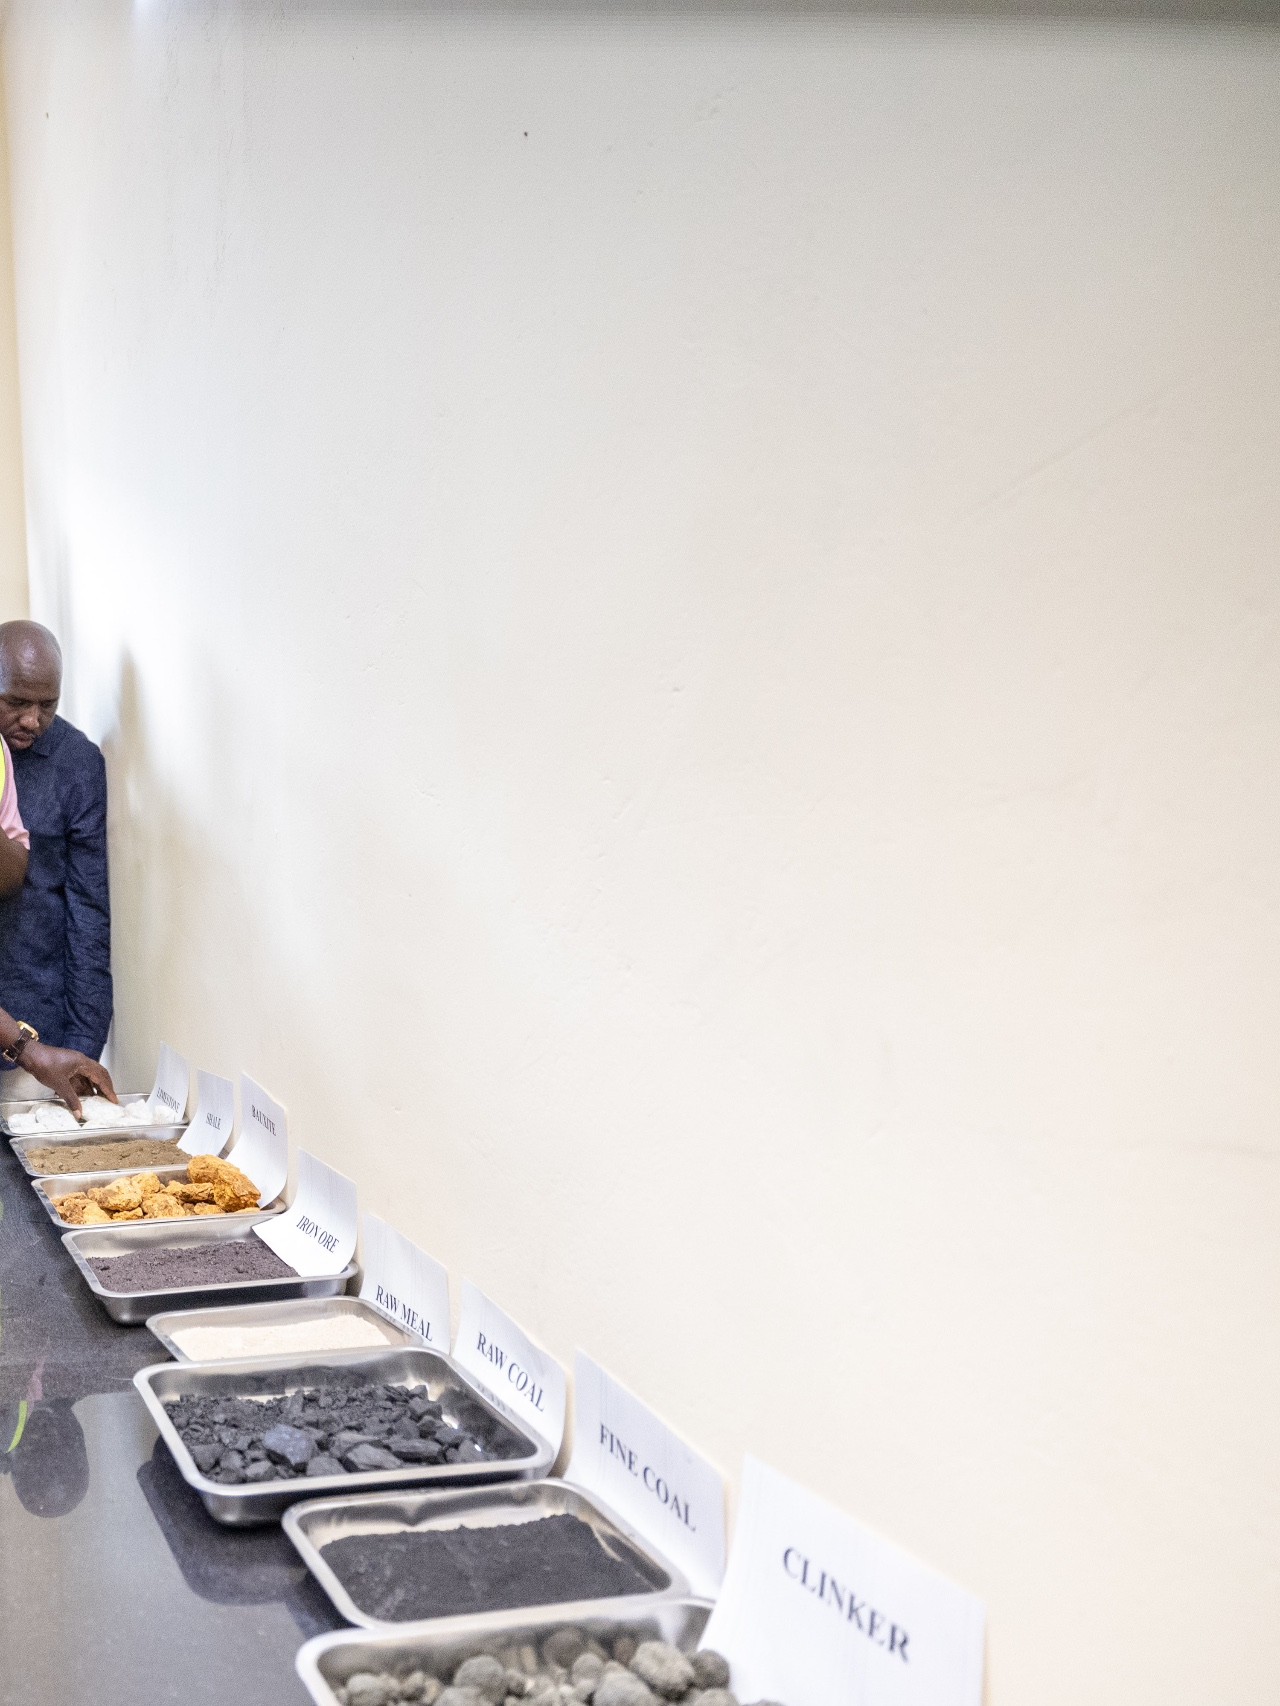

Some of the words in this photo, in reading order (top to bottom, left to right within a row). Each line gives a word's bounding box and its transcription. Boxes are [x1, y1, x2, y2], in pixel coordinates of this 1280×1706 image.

[206, 1112, 221, 1131] SHALE
[251, 1104, 276, 1137] BAUXITE
[296, 1215, 321, 1238] IRON
[319, 1230, 340, 1254] ORE
[376, 1285, 400, 1315] RAW
[401, 1304, 433, 1342] MEAL
[476, 1332, 508, 1370] RAW
[508, 1362, 544, 1413] COAL
[600, 1423, 639, 1477] FINE
[642, 1466, 696, 1532] COAL
[783, 1547, 910, 1664] CLINKER
